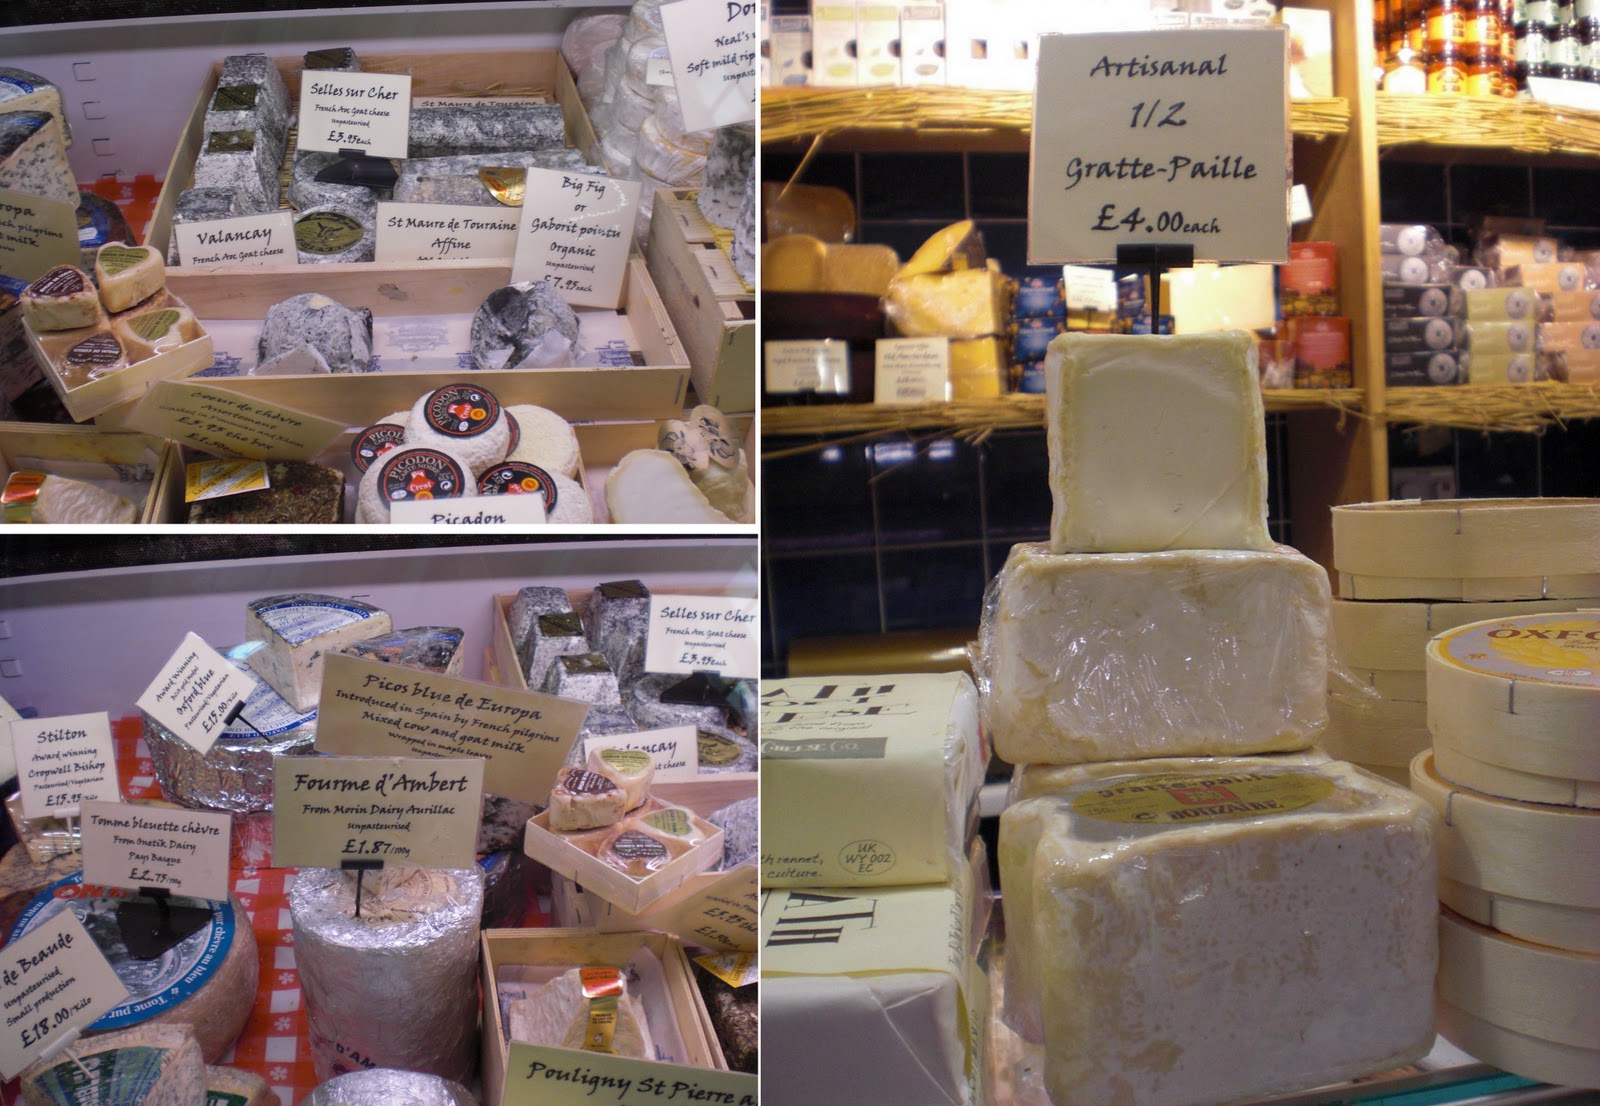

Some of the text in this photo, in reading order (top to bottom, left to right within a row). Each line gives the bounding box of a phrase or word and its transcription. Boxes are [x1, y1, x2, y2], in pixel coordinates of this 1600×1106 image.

[715, 31, 749, 47] Neal's
[687, 59, 710, 77] Soft
[712, 53, 739, 68] mild
[1090, 54, 1227, 77] Artisanal
[310, 83, 398, 100] Selles sur Cher
[315, 104, 336, 112] French
[351, 107, 367, 117] Goat
[369, 109, 390, 117] cheese
[1129, 99, 1187, 128] 1/2
[331, 118, 370, 128] unpasteurised
[1065, 155, 1257, 190] Gratte-Paille
[562, 176, 606, 200] Big Fig
[574, 204, 587, 212] or
[18, 224, 63, 238] pilgrims
[388, 216, 517, 232] St Maure de Touraine
[531, 217, 621, 240] Gaborit pointu
[7, 235, 39, 247] milk
[196, 226, 272, 246] Valancay
[431, 238, 471, 254] Affine
[550, 242, 596, 260] Organic
[192, 253, 221, 265] French
[239, 250, 258, 262] Goat
[260, 248, 285, 257] cheese
[546, 260, 595, 274] unpasteurised
[191, 392, 303, 427] Coeur de chèvre
[433, 390, 458, 425] PICODON
[225, 429, 248, 442] the
[250, 438, 275, 450] box
[389, 456, 447, 479] PICODON
[398, 464, 416, 481] CARTE
[417, 463, 440, 476] NOIRE
[410, 482, 431, 491] Crest
[431, 511, 506, 524] Picadon
[660, 607, 756, 622] Selles sur Cher
[665, 627, 690, 636] French
[707, 629, 724, 639] Goat
[725, 630, 747, 638] cheese
[684, 640, 727, 649] unpasteurised
[156, 679, 177, 702] Award
[176, 669, 214, 715] Oxford blue
[363, 674, 542, 723] Picos blue de Europa
[336, 690, 560, 742] Introduced in Spain by French pilgrims
[37, 729, 87, 744] Stilton
[362, 711, 525, 754] Mixed cow and goat milk
[32, 748, 97, 762] Award winning
[388, 732, 426, 744] wrapped
[438, 744, 465, 755] maple
[466, 750, 492, 760] leaves
[28, 761, 105, 781] Cropwell Bishop
[663, 760, 686, 769] cheese
[294, 771, 468, 797] Fourme d'Ambert
[303, 805, 456, 819] From Morin Dairy Aurillac
[91, 815, 220, 835] Tomme bleuette chèvre
[348, 822, 411, 834] unpasteurised
[113, 835, 135, 845] From
[169, 841, 196, 855] Dairy
[857, 843, 878, 853] UK
[128, 852, 182, 866] Pays Basque
[776, 853, 824, 865] rennet,
[845, 854, 891, 864] WY 002
[767, 867, 823, 879] culture.
[858, 864, 874, 873] EC
[27, 902, 44, 917] bleu
[184, 911, 226, 984] pur chèvre au bleu
[3, 932, 73, 986] de Beaude
[4, 966, 62, 1010] unpasteurised
[7, 977, 76, 1027] Small production
[108, 996, 168, 1019] Tome pur
[526, 1062, 632, 1100] Pouligny
[637, 1078, 667, 1095] St
[668, 1081, 735, 1103] Pierre
